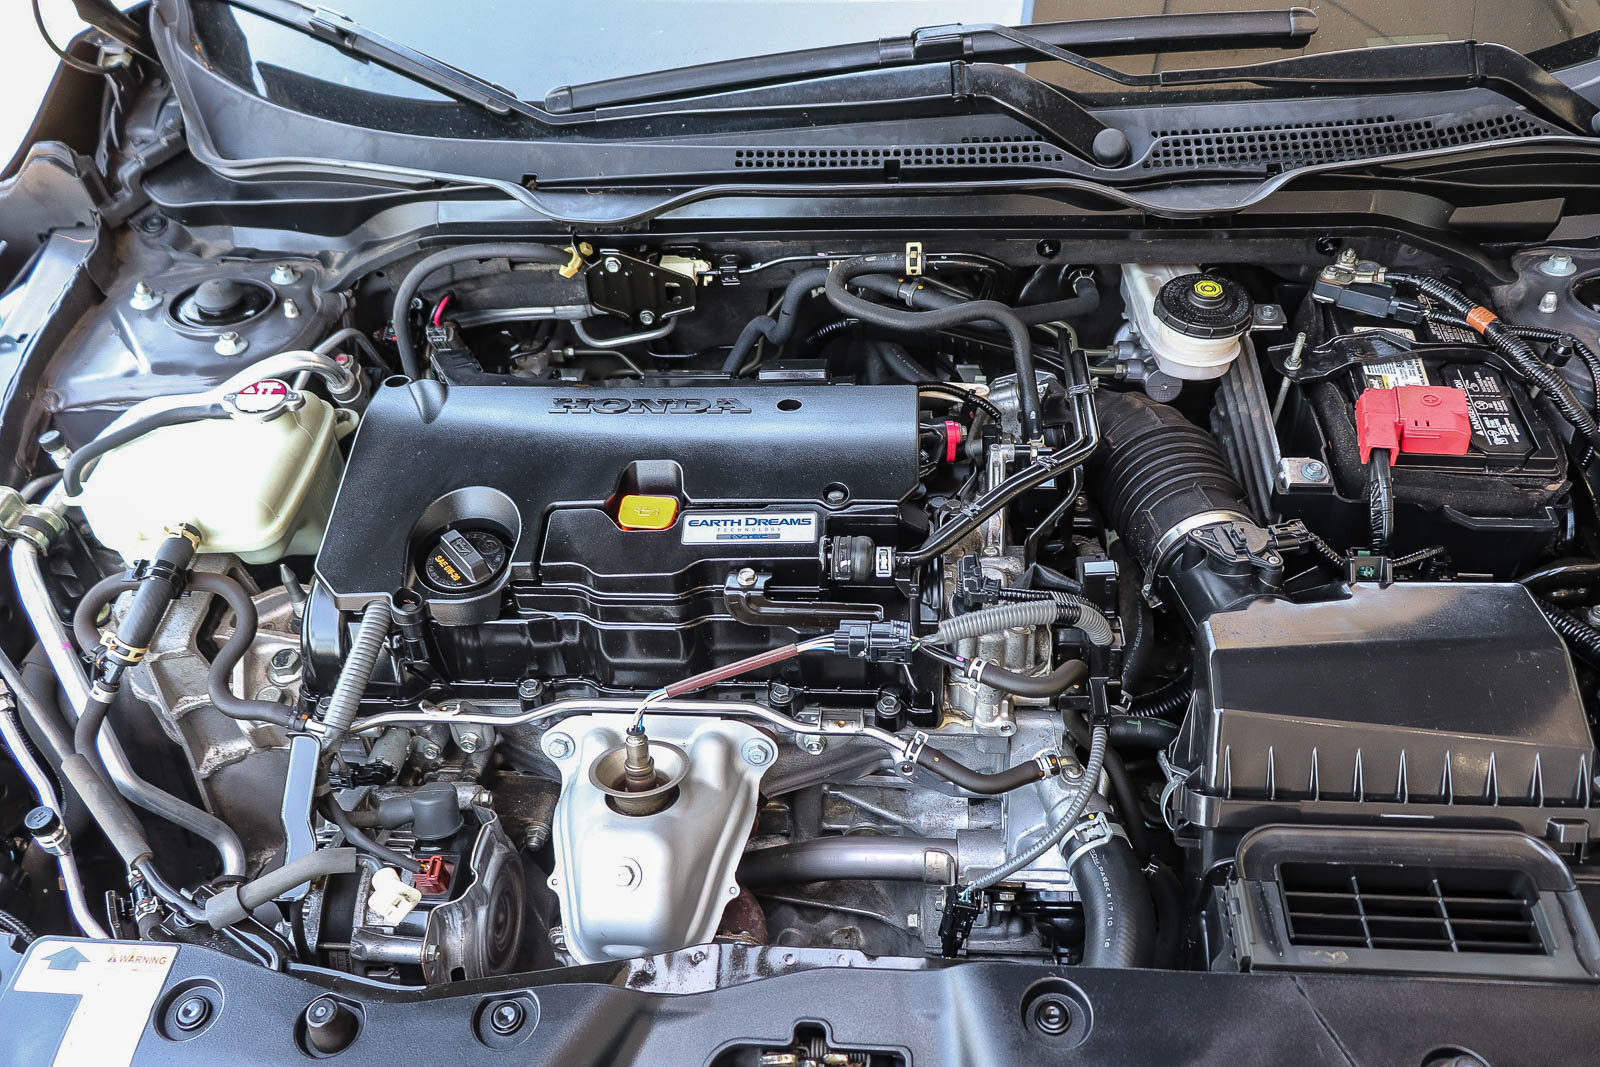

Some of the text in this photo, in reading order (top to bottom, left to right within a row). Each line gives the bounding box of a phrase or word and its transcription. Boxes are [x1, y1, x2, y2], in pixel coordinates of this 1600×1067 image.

[549, 398, 752, 414] HONDA
[688, 517, 812, 527] EARTH DREAMS
[434, 555, 449, 568] SAE
[119, 955, 168, 965] WARNING
